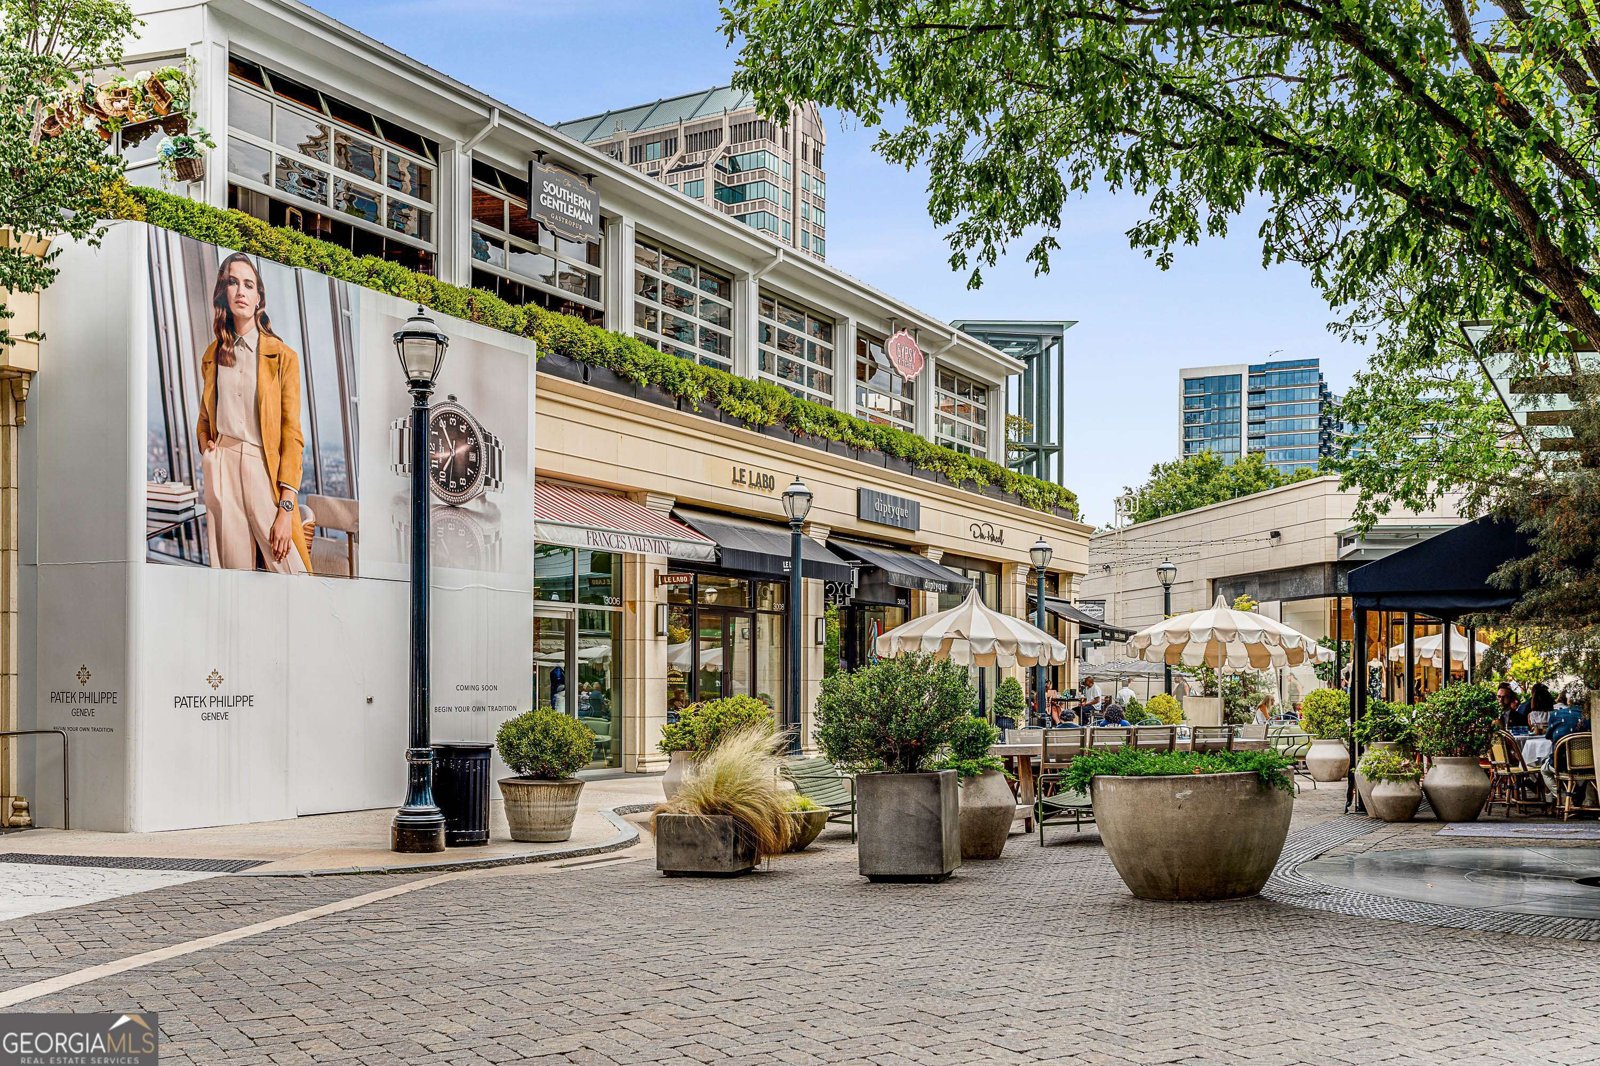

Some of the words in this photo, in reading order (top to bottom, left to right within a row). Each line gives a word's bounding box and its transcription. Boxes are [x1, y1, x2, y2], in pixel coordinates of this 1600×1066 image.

[543, 180, 591, 211] SOUTHERN
[540, 193, 593, 225] GENTLEMAN
[550, 213, 583, 230] GASTROPUB
[732, 466, 746, 485] LE
[748, 470, 775, 491] LABO
[874, 498, 909, 521] diptyque
[586, 530, 627, 550] FRANCES
[627, 535, 672, 555] VALENTINE
[924, 579, 948, 593] diptyque
[50, 691, 77, 704] PATEK
[78, 691, 118, 704] PHILIPPE
[174, 695, 207, 708] PATEK
[209, 695, 254, 708] PHILIPPE
[71, 708, 96, 717] GENEVE
[200, 711, 229, 721] GENEVE
